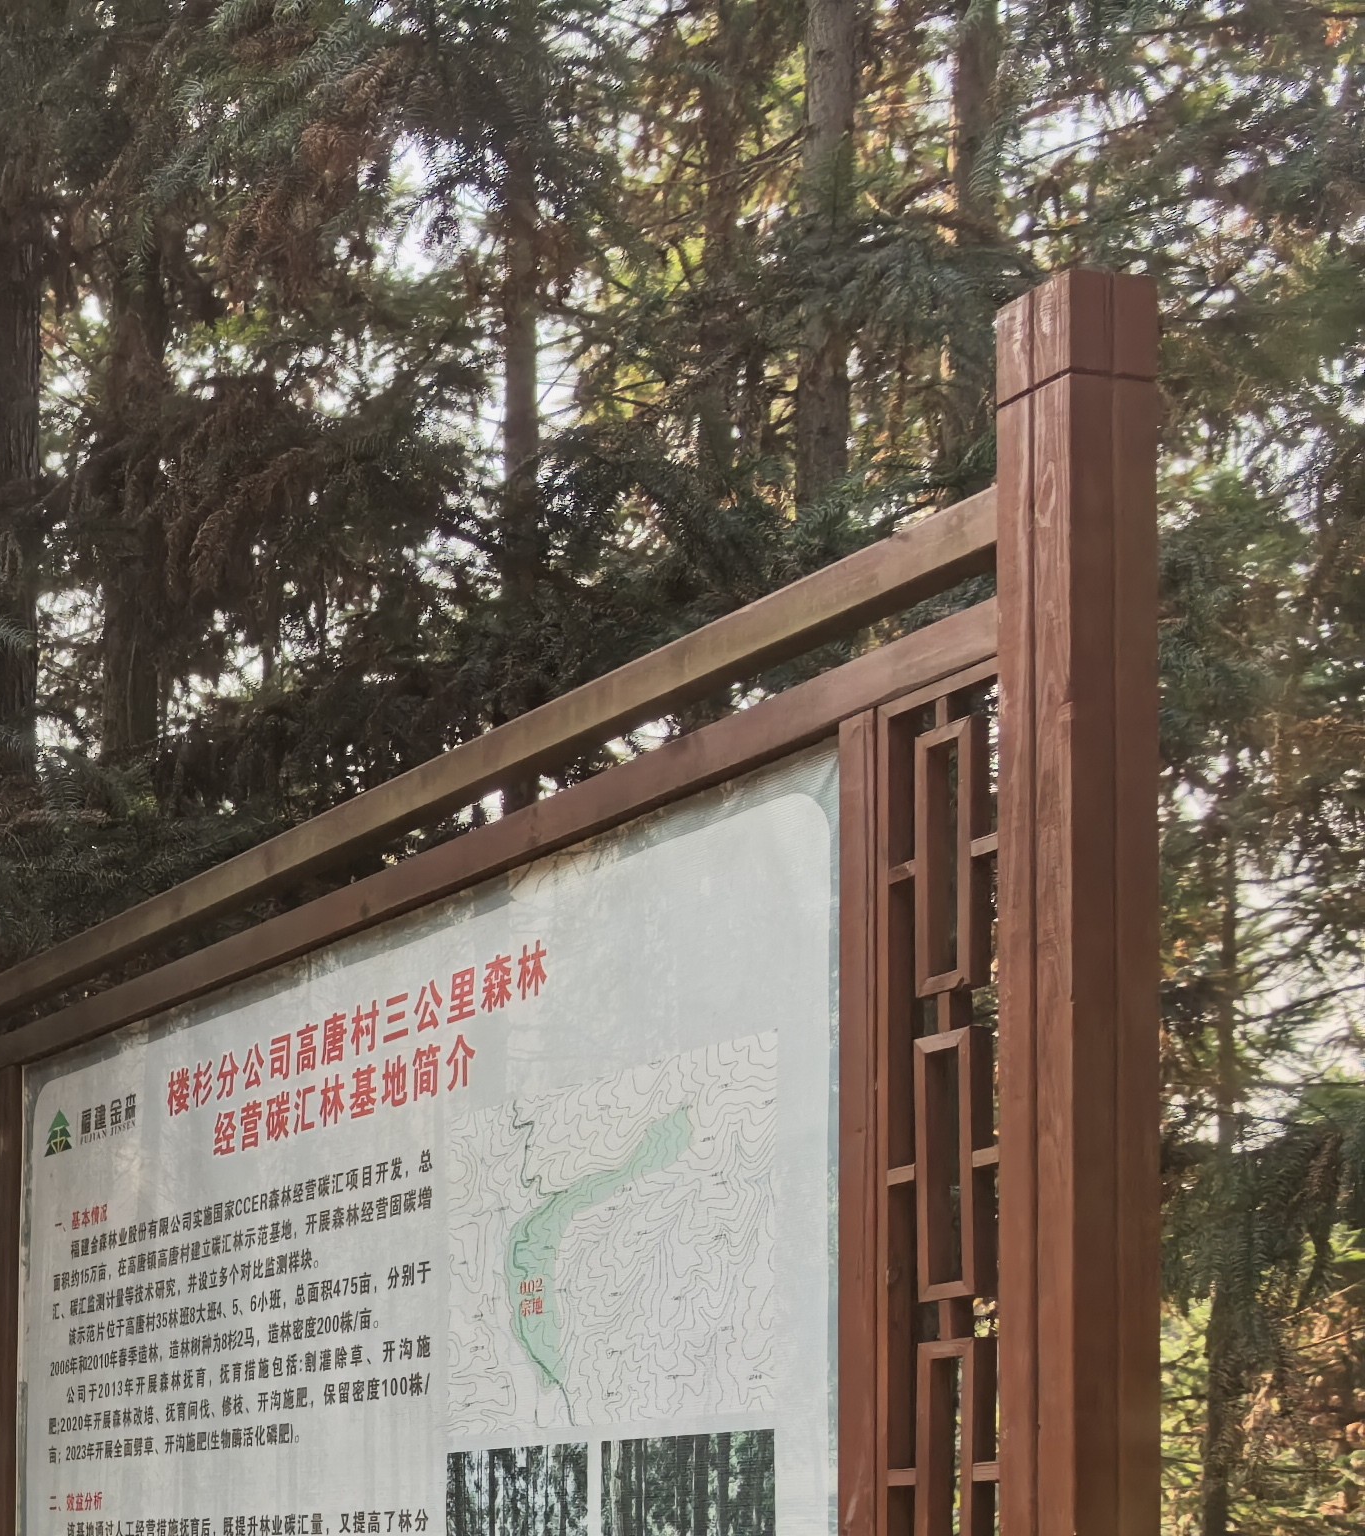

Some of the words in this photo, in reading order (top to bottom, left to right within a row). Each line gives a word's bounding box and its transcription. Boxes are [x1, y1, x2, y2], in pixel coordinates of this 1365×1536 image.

[167, 939, 548, 1117] 楼杉分公司高唐村三公里森林
[81, 1093, 137, 1136] 福建金森
[213, 1034, 476, 1156] 经营碳汇林基地简介
[54, 1203, 108, 1233] 一、基本情况
[48, 1491, 103, 1512] 二、效益分析
